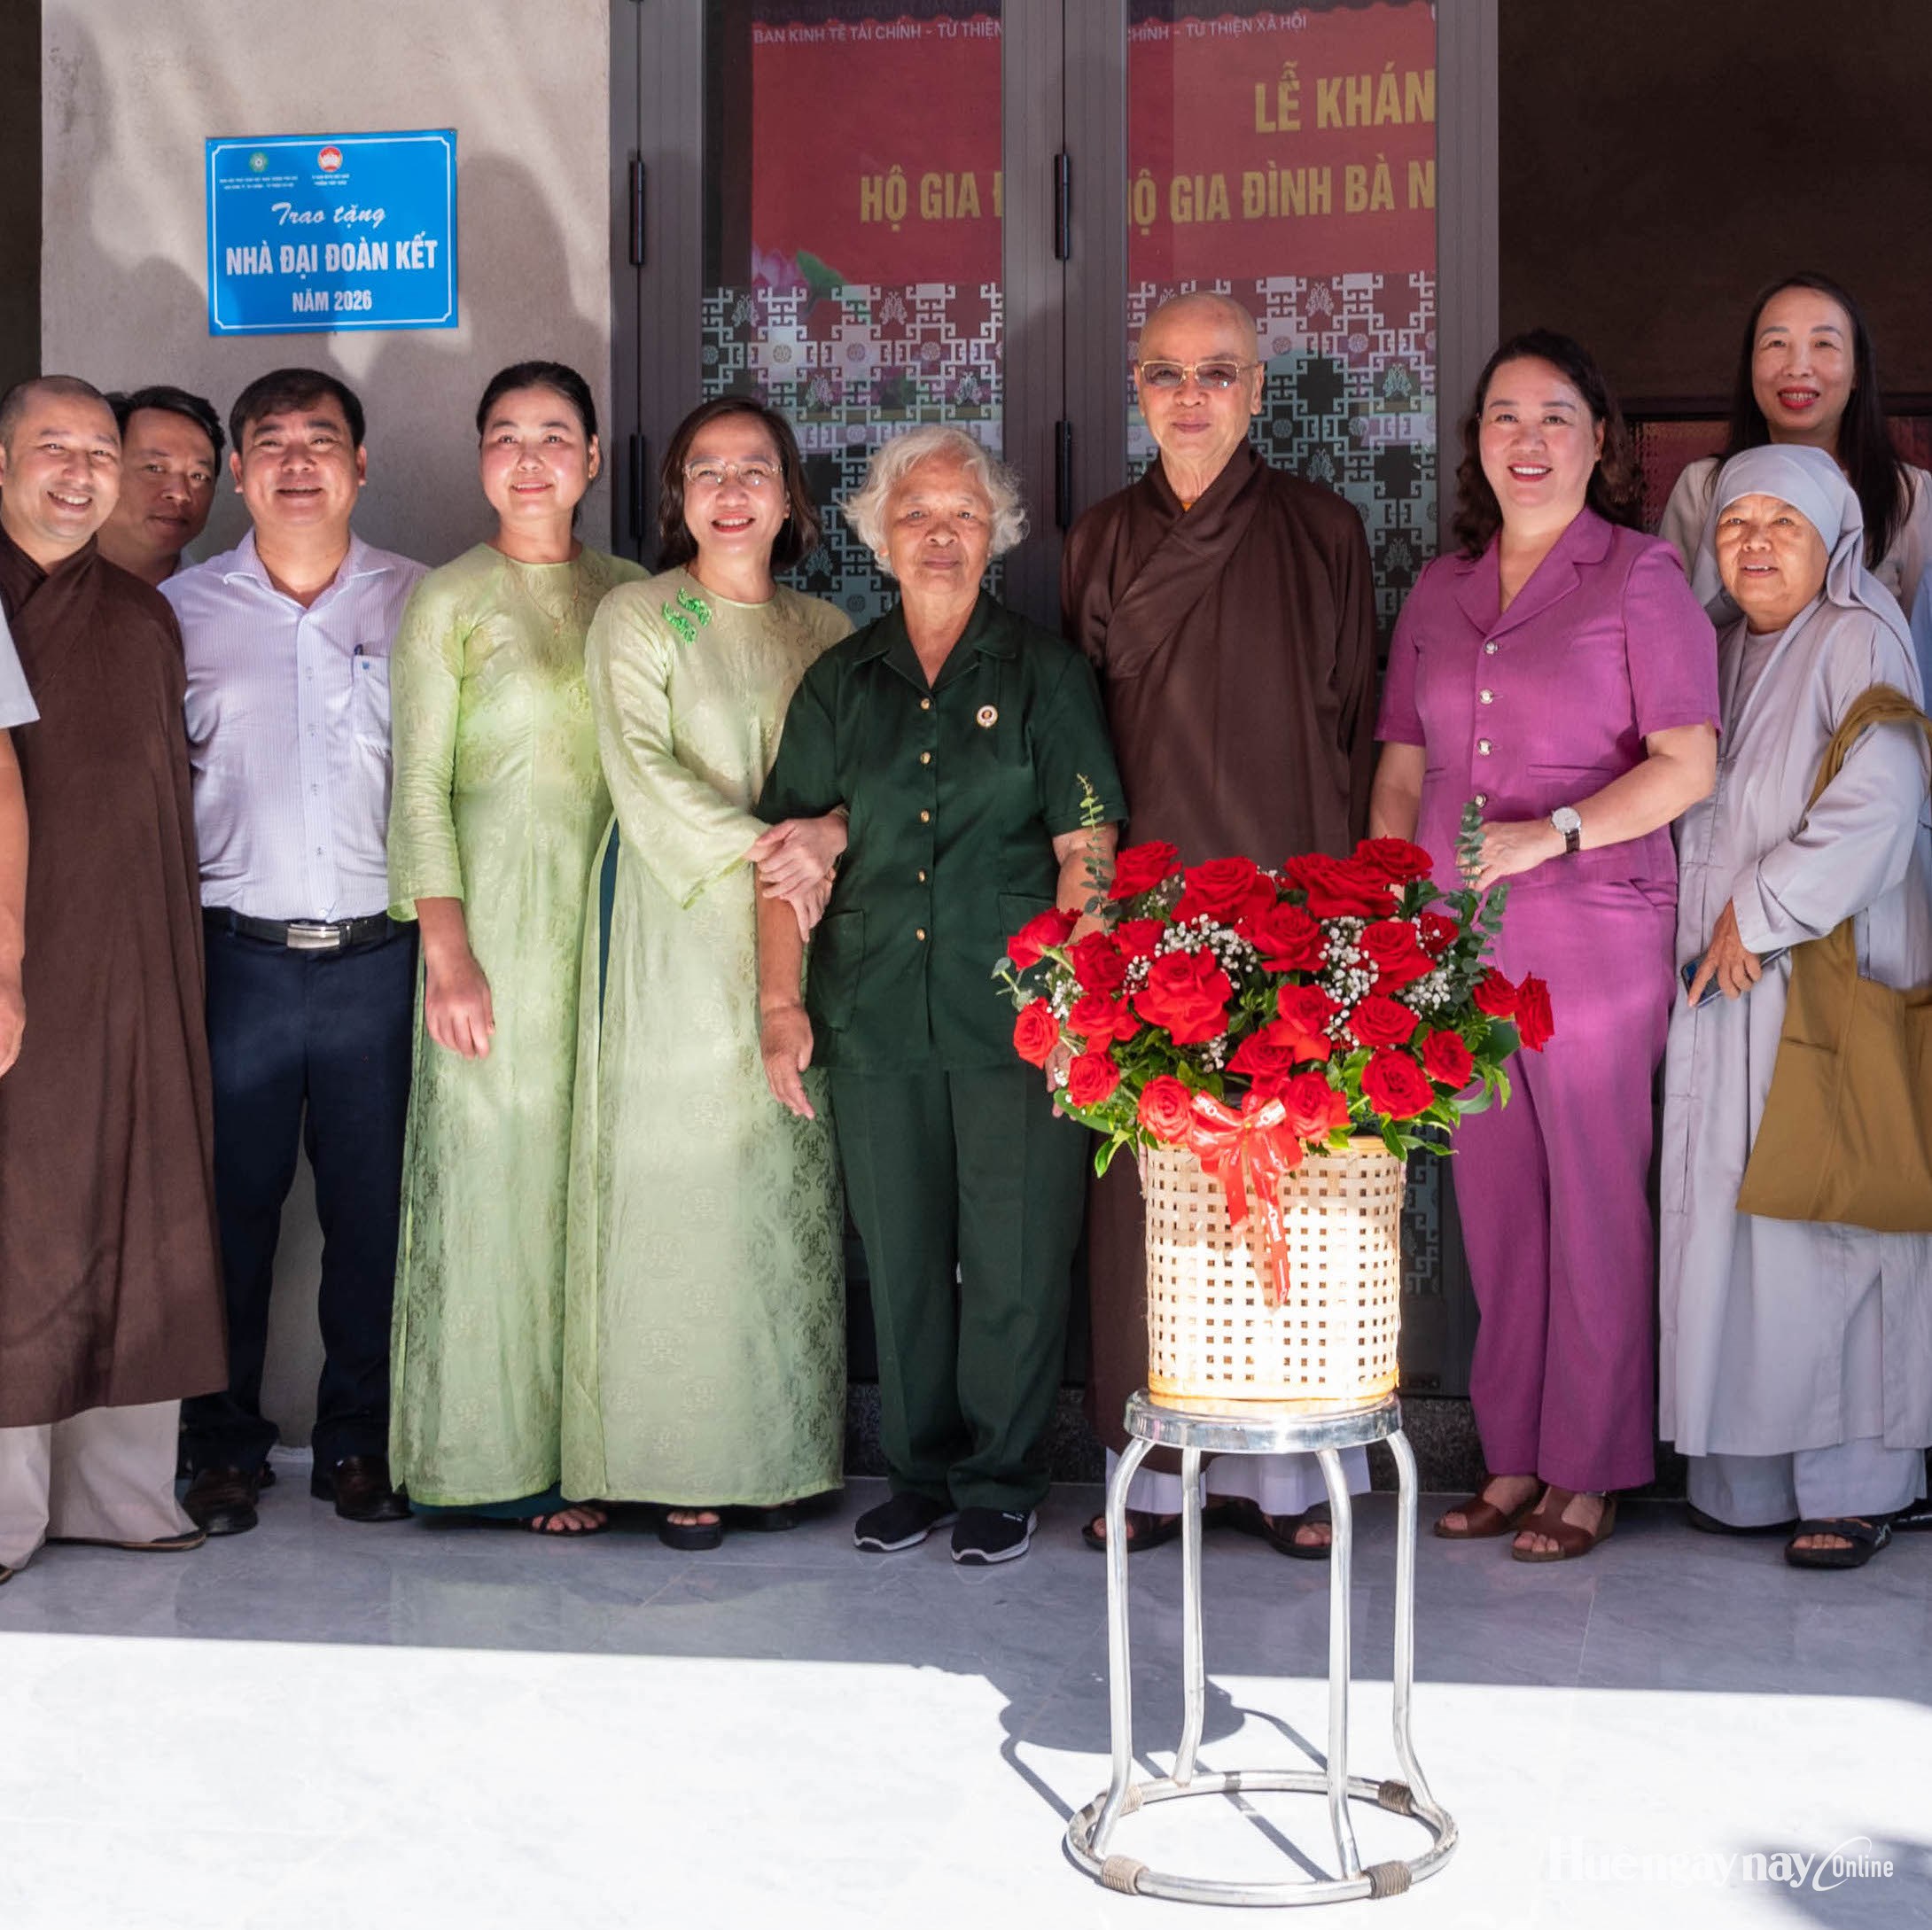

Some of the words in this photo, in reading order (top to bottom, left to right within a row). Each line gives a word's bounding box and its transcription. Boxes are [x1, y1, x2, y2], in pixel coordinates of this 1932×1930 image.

[753, 28, 785, 43] BAN
[789, 27, 825, 43] KINH
[851, 22, 871, 41] TÀI
[875, 19, 922, 40] CHÍNH
[1209, 15, 1252, 39] THIỆN
[1280, 12, 1306, 34] HỘI
[1255, 60, 1301, 134] LỄ
[1316, 61, 1436, 129] KHÁN
[861, 164, 908, 232] HỘ
[920, 171, 981, 220] GIA
[1170, 174, 1232, 223] GIA
[1242, 160, 1332, 220] ĐÌNH
[1344, 152, 1396, 214] BÀ
[271, 201, 326, 226] Trao
[333, 204, 386, 229] tặng
[226, 240, 274, 276] NHÀ
[280, 243, 319, 280] ĐẠI
[325, 236, 389, 273] ĐOÀN
[395, 231, 439, 269] KẾT
[292, 288, 330, 313] NĂM
[333, 290, 373, 312] 2026
